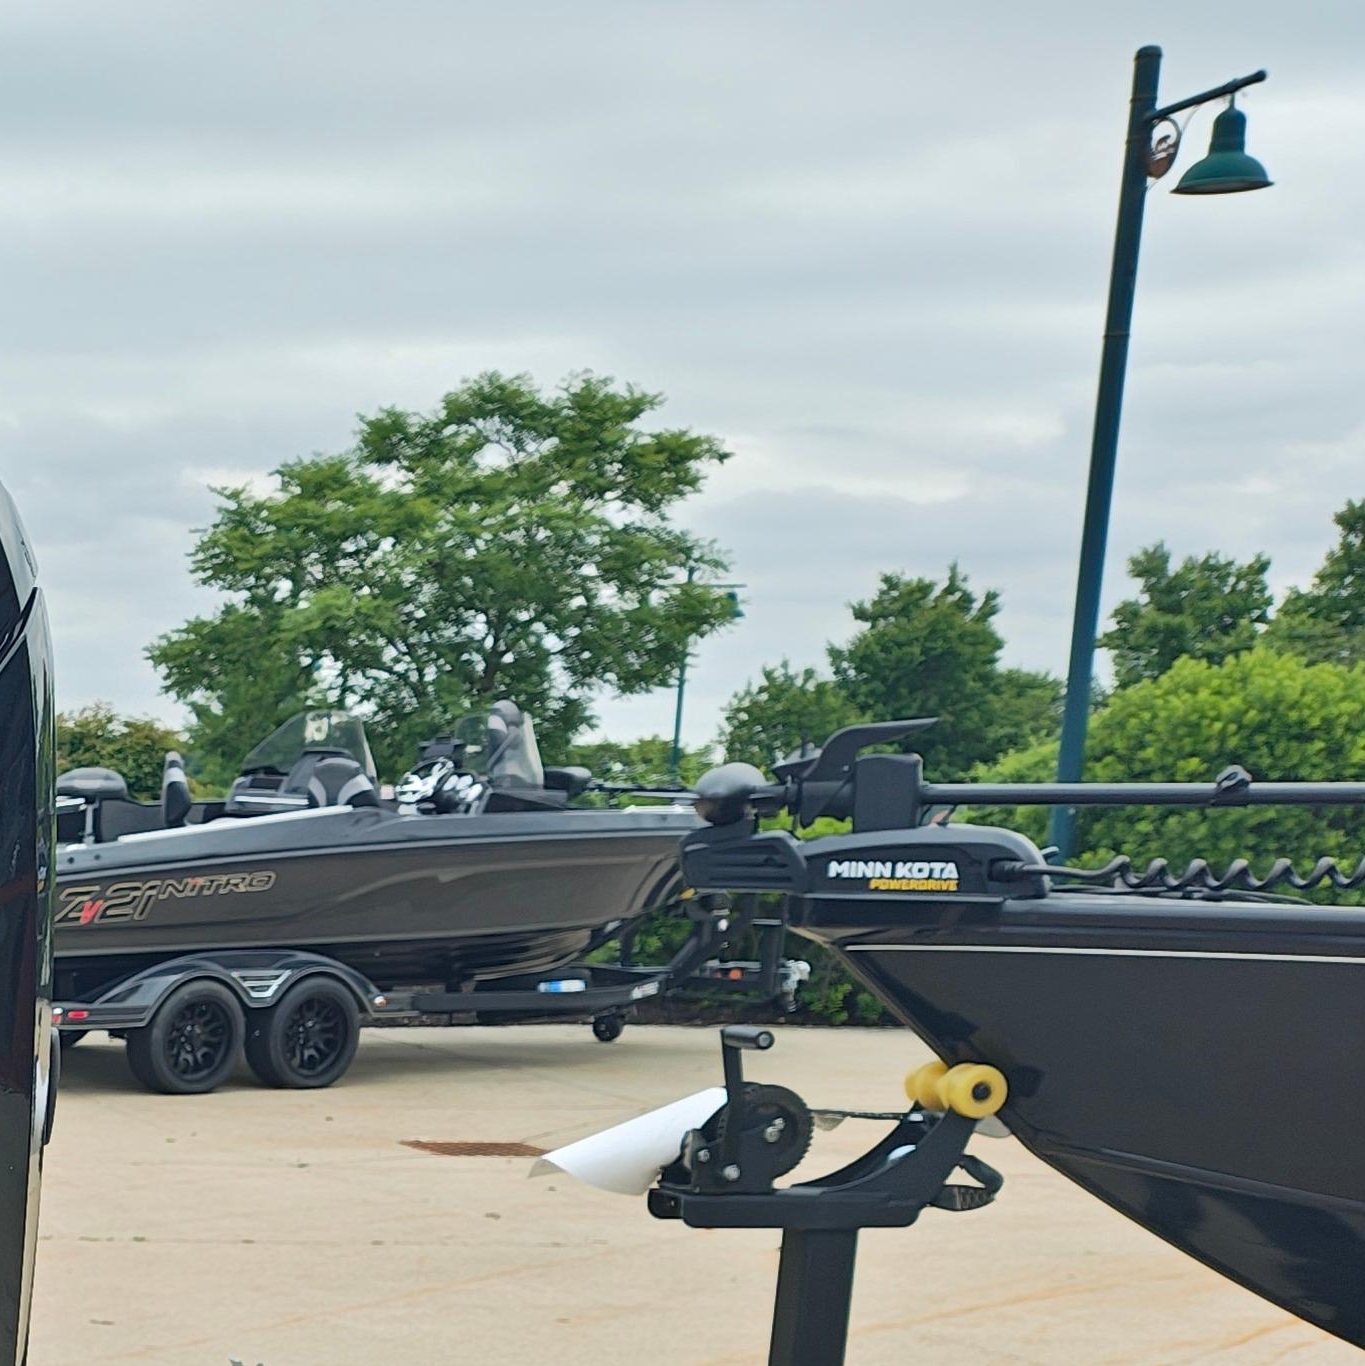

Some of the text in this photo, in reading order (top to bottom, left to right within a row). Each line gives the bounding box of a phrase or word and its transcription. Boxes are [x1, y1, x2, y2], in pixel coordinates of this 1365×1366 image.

[828, 861, 959, 879] MINN KOTA
[158, 871, 277, 899] NITRO
[869, 879, 958, 891] POWERDRIVE
